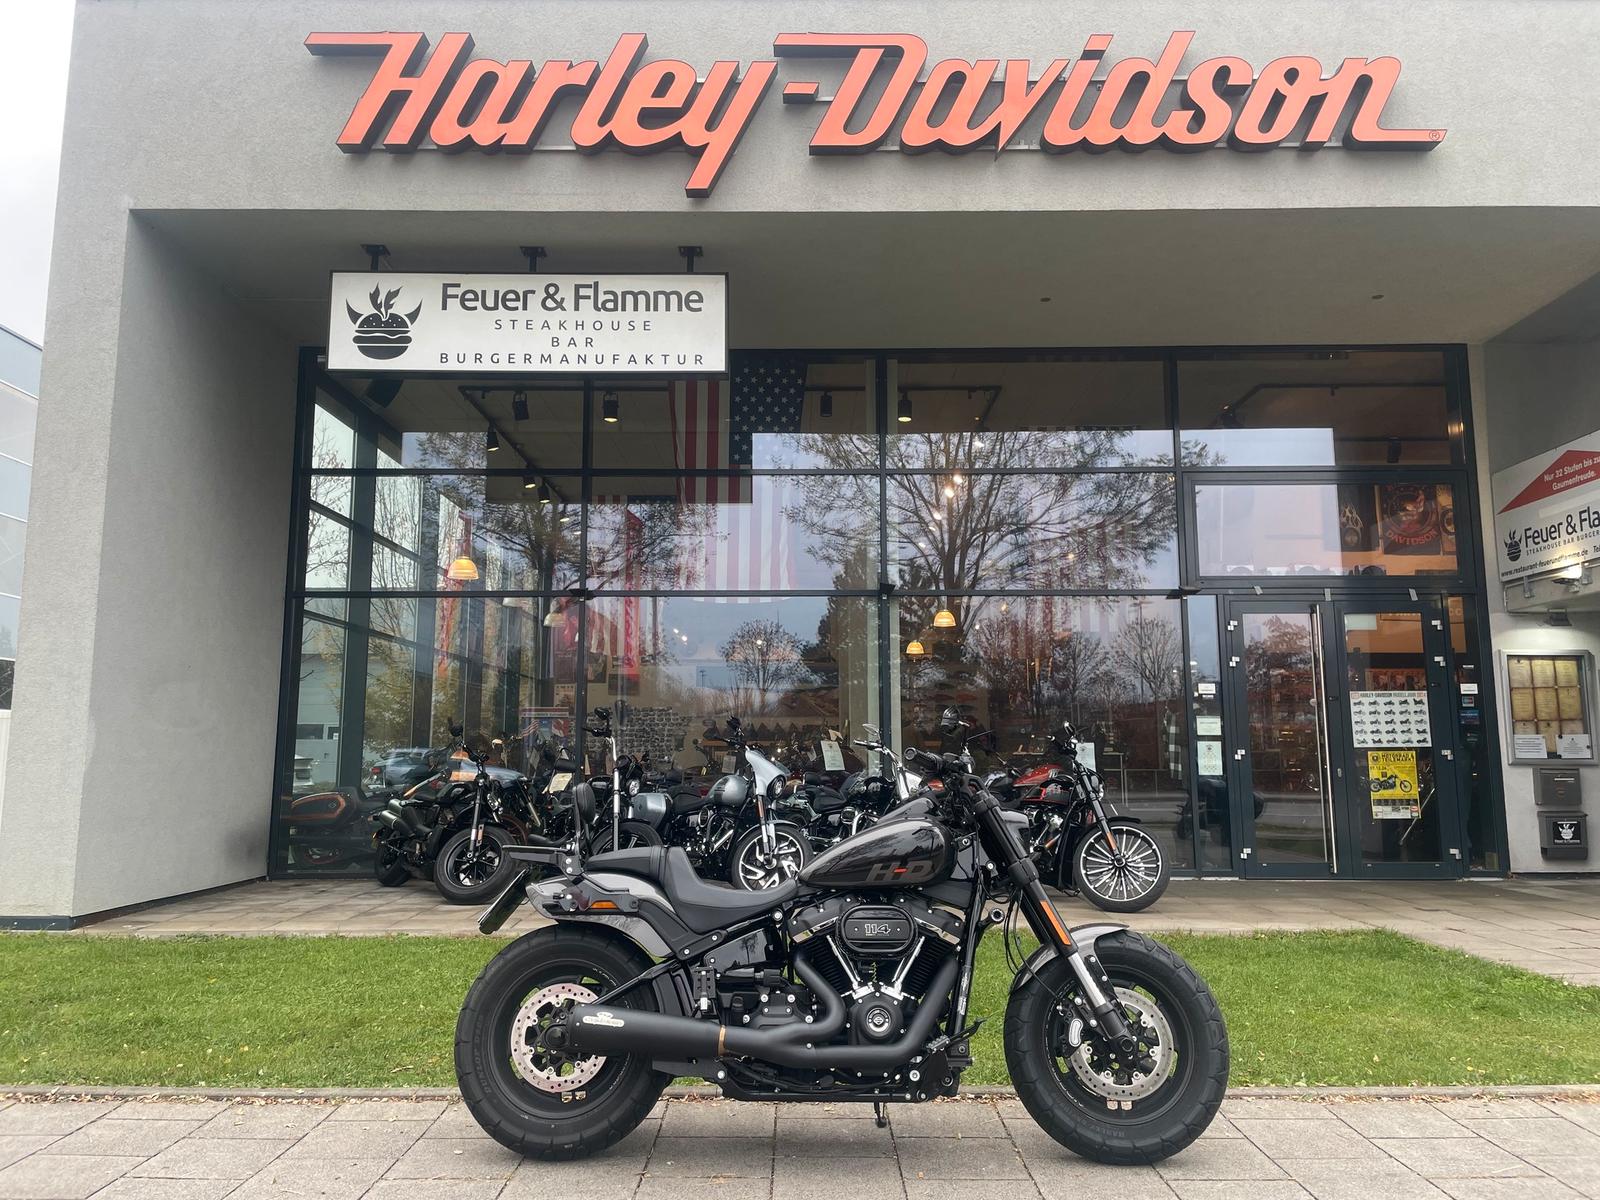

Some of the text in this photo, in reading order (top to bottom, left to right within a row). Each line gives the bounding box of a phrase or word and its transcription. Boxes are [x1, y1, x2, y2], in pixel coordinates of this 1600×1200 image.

[441, 281, 705, 313] Feuer & Flamme
[494, 319, 652, 332] STEAKHOUSE
[551, 336, 595, 349] BAR
[440, 353, 705, 366] BURGERMANUFAKTUR
[1543, 473, 1554, 482] Nur
[1555, 468, 1563, 478] 32
[1564, 463, 1582, 475] Stufen
[1583, 458, 1593, 468] bis
[1524, 506, 1600, 548] Feuer & Fla
[1386, 529, 1438, 545] DAVIDSON
[1526, 540, 1561, 556] STEAKHOUSE
[1563, 537, 1574, 546] BAR
[866, 861, 936, 882] H-D
[865, 923, 891, 934] 114
